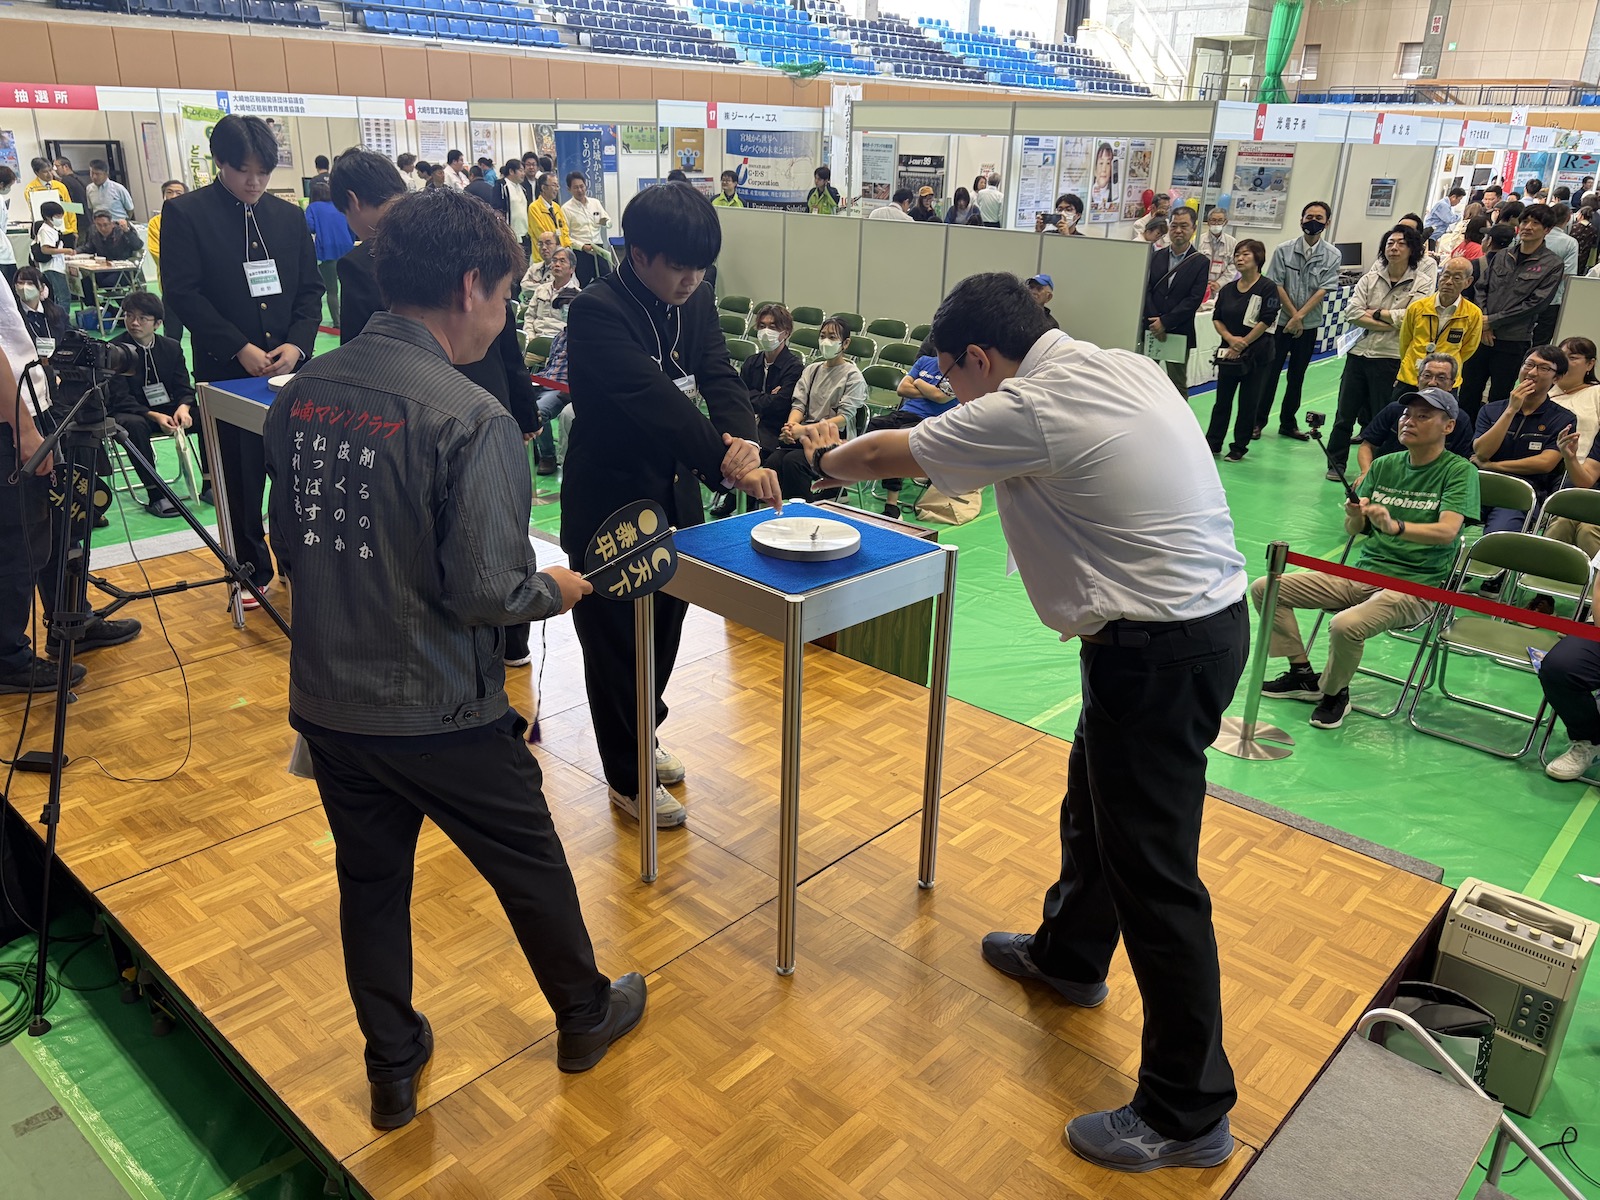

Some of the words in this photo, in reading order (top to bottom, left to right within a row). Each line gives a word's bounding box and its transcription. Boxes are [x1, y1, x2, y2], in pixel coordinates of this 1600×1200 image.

[14, 89, 69, 104] 抽選所
[407, 105, 414, 114] 6
[708, 110, 716, 121] 17
[1256, 115, 1265, 129] 29
[1563, 154, 1580, 169] R
[747, 179, 780, 187] Corporation
[303, 433, 327, 546] ねっぱすか
[334, 440, 351, 552] 抜くのか
[358, 446, 376, 560] 削るのか
[608, 556, 653, 597] 天下
